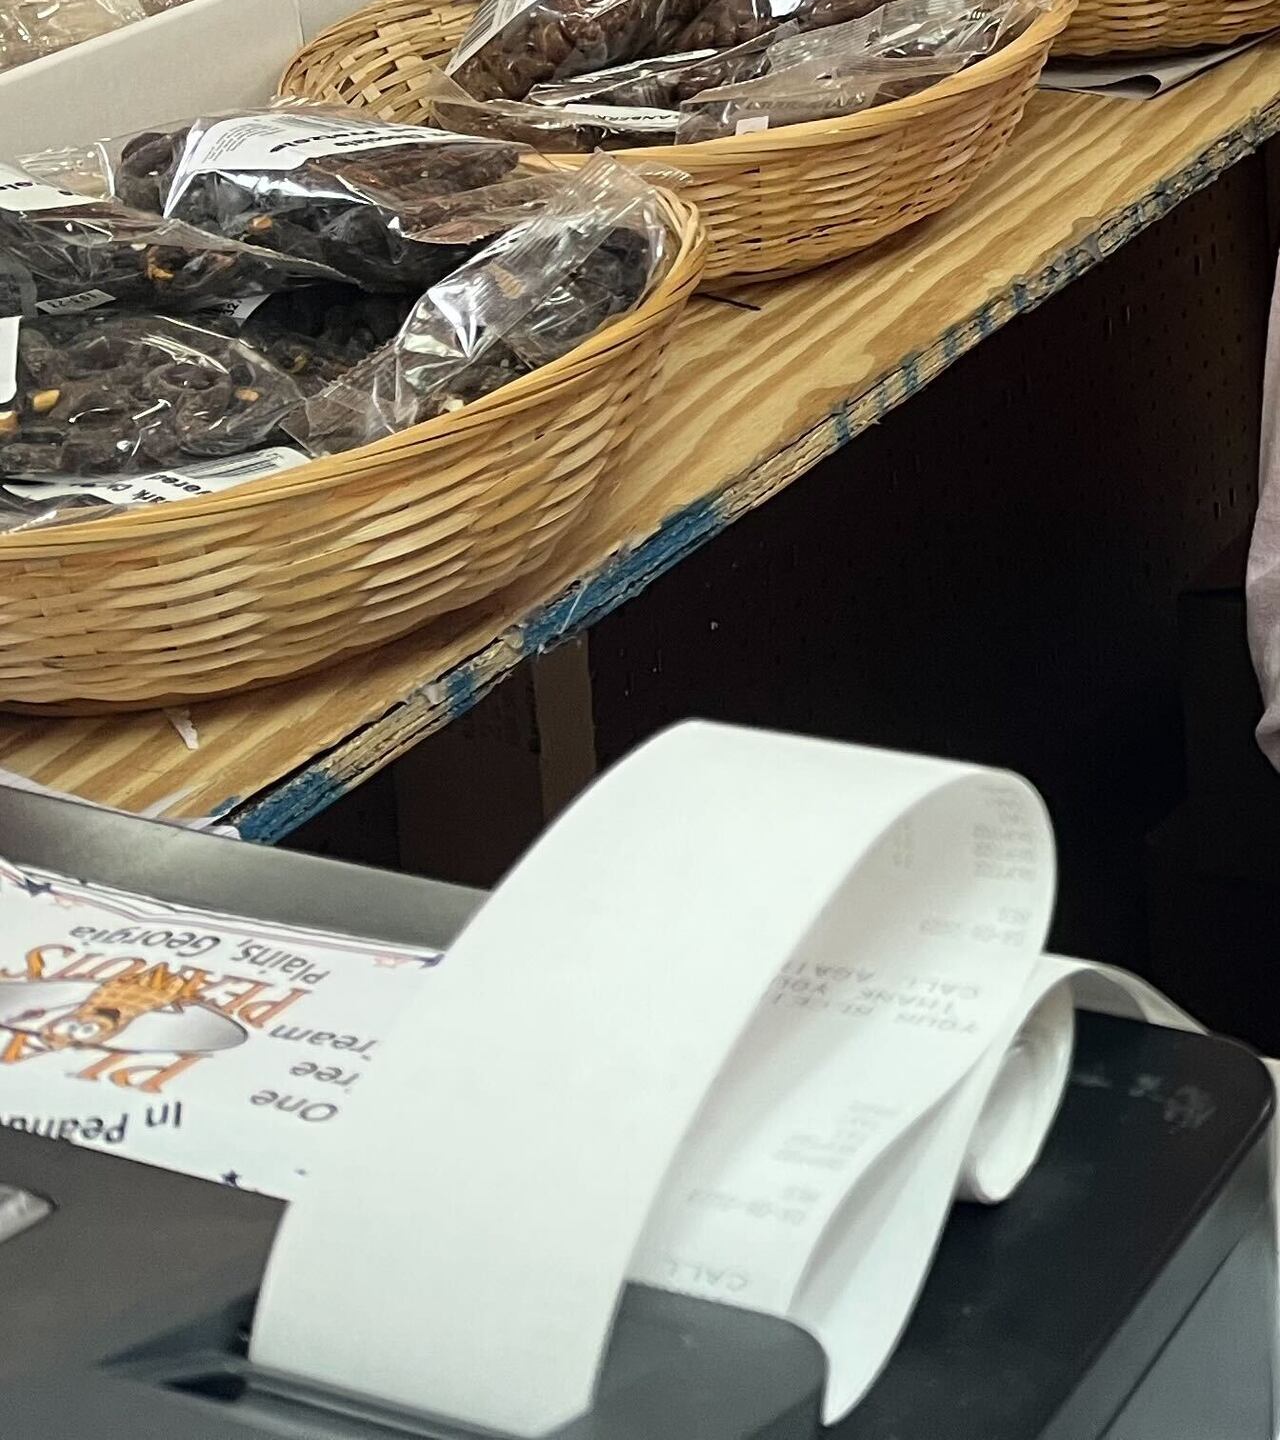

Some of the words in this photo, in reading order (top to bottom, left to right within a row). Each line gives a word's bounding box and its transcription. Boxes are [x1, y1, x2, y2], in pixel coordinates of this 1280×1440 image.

[68, 925, 221, 959] Georgia
[230, 937, 331, 986] Plains,
[144, 1100, 183, 1129] In
[249, 1087, 340, 1124] One
[661, 1259, 751, 1293] CALL
